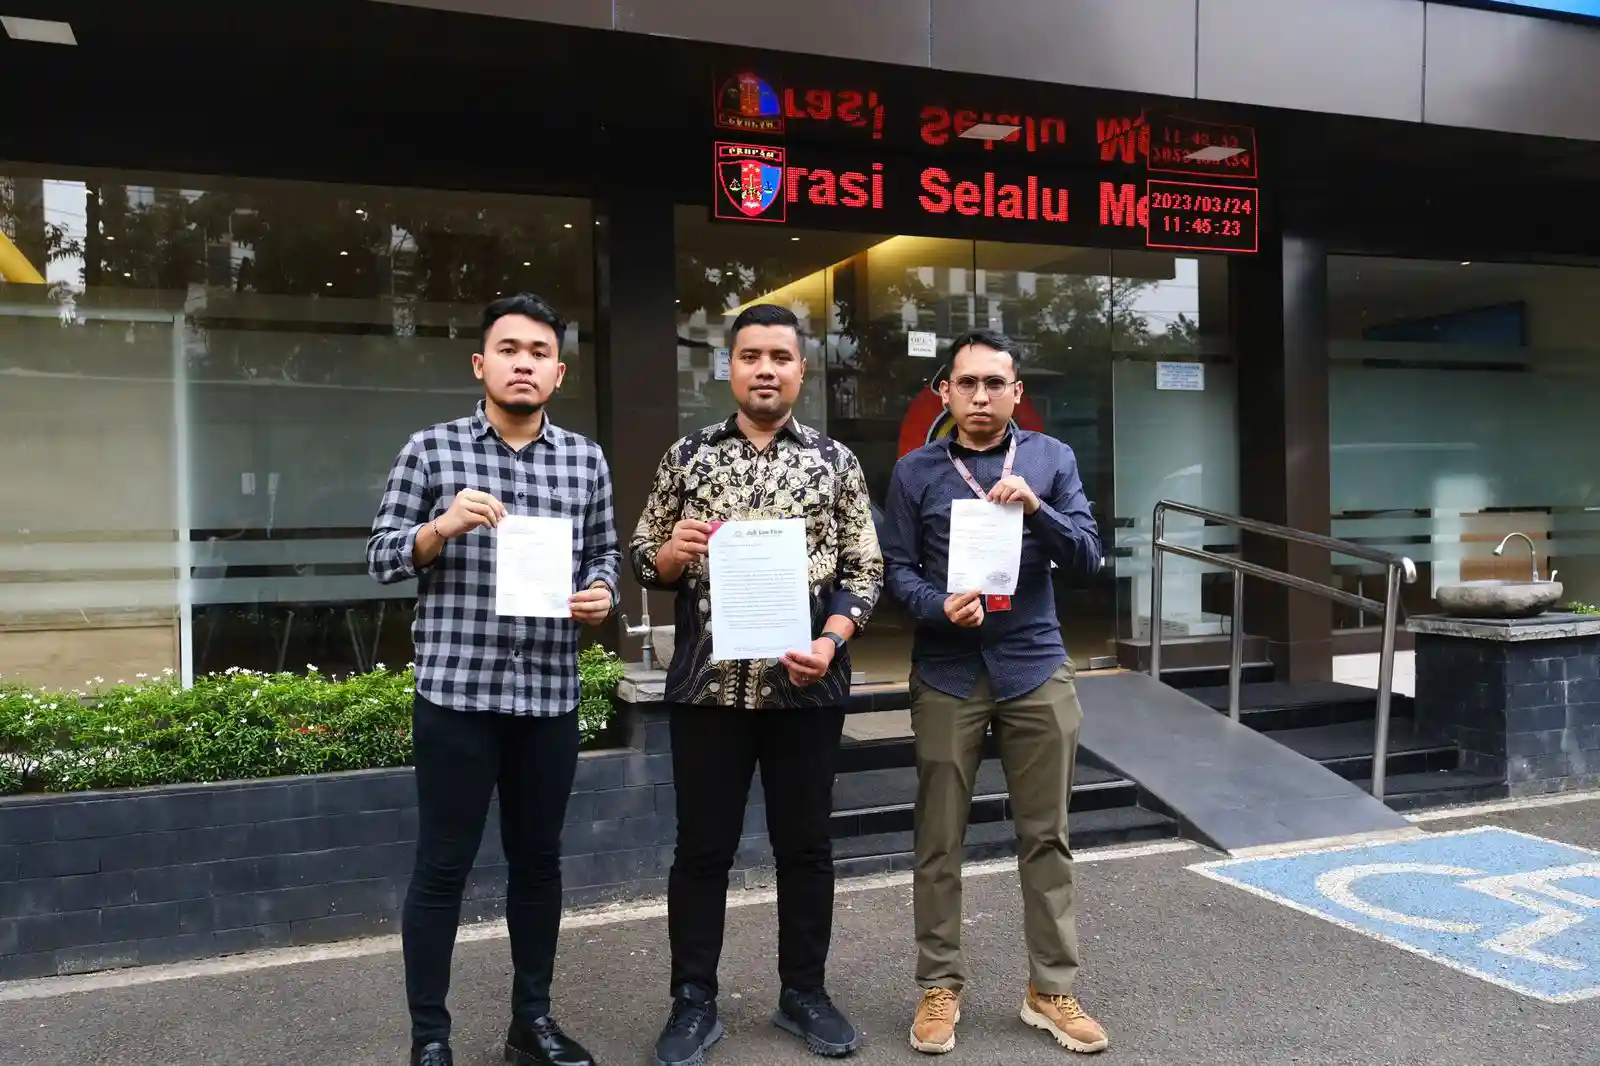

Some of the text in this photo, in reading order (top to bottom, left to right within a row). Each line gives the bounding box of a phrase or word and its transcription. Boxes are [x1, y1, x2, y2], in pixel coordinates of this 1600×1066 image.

[787, 162, 884, 209] rasi
[919, 167, 1069, 222] Selalu
[1152, 192, 1252, 215] 2023/03/24
[1163, 215, 1241, 236] 11:45:23
